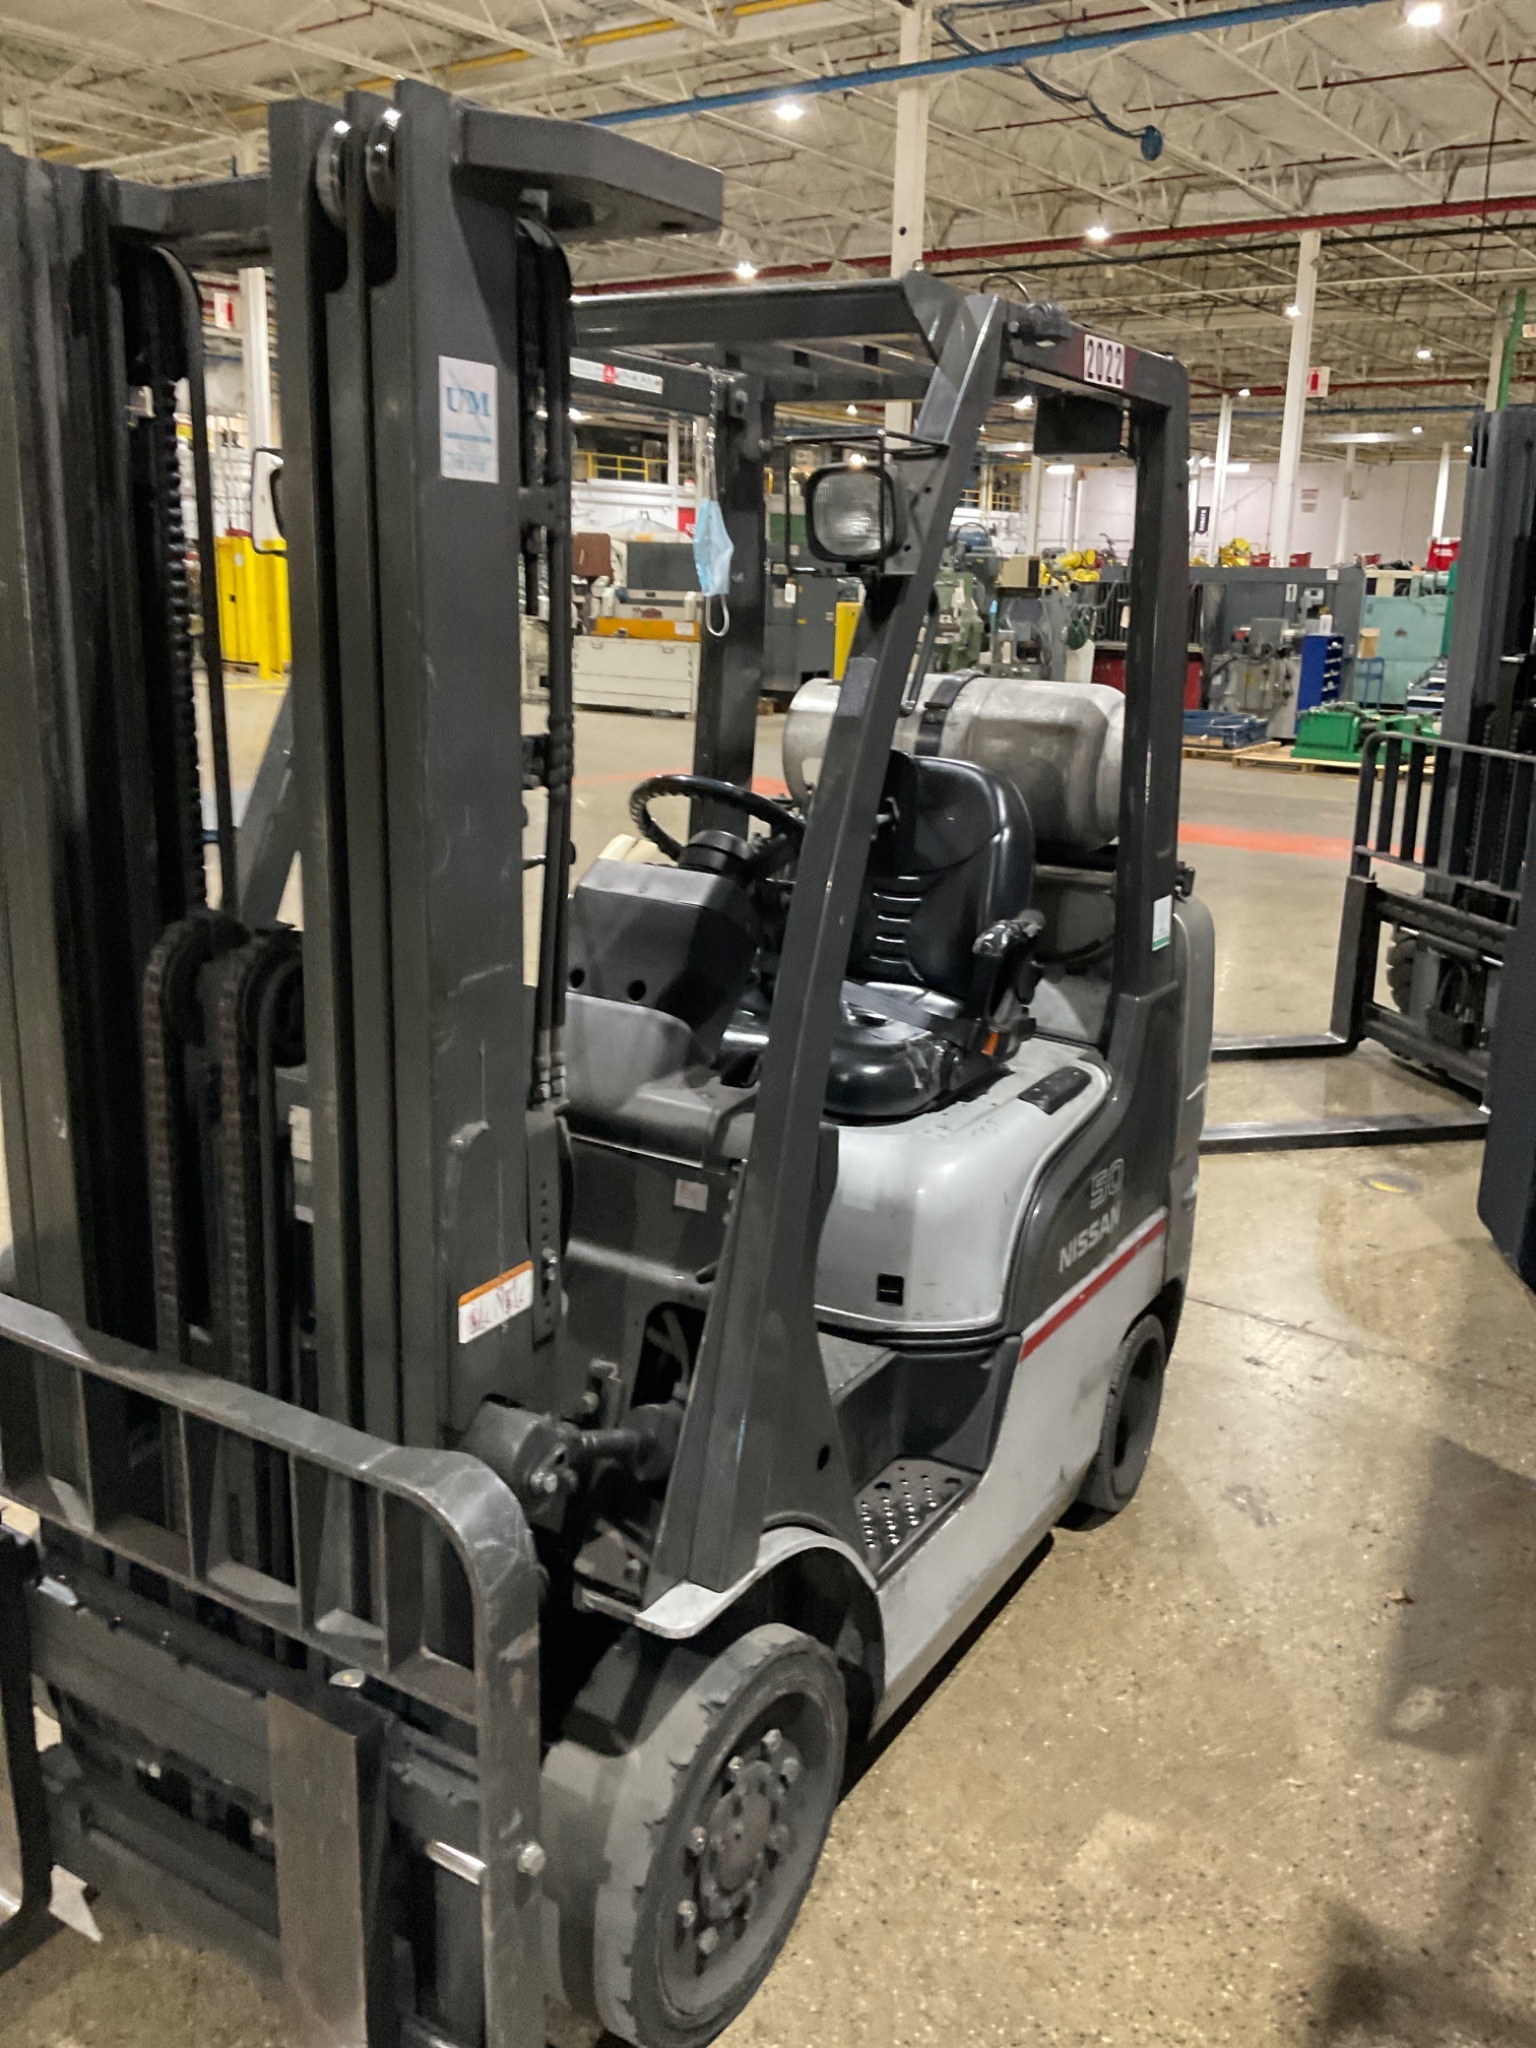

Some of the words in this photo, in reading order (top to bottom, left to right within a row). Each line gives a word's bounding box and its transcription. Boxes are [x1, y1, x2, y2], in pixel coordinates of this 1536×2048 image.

[1086, 339, 1123, 385] 2022
[1090, 1158, 1124, 1210] 50
[1058, 1200, 1121, 1273] NISSAN
